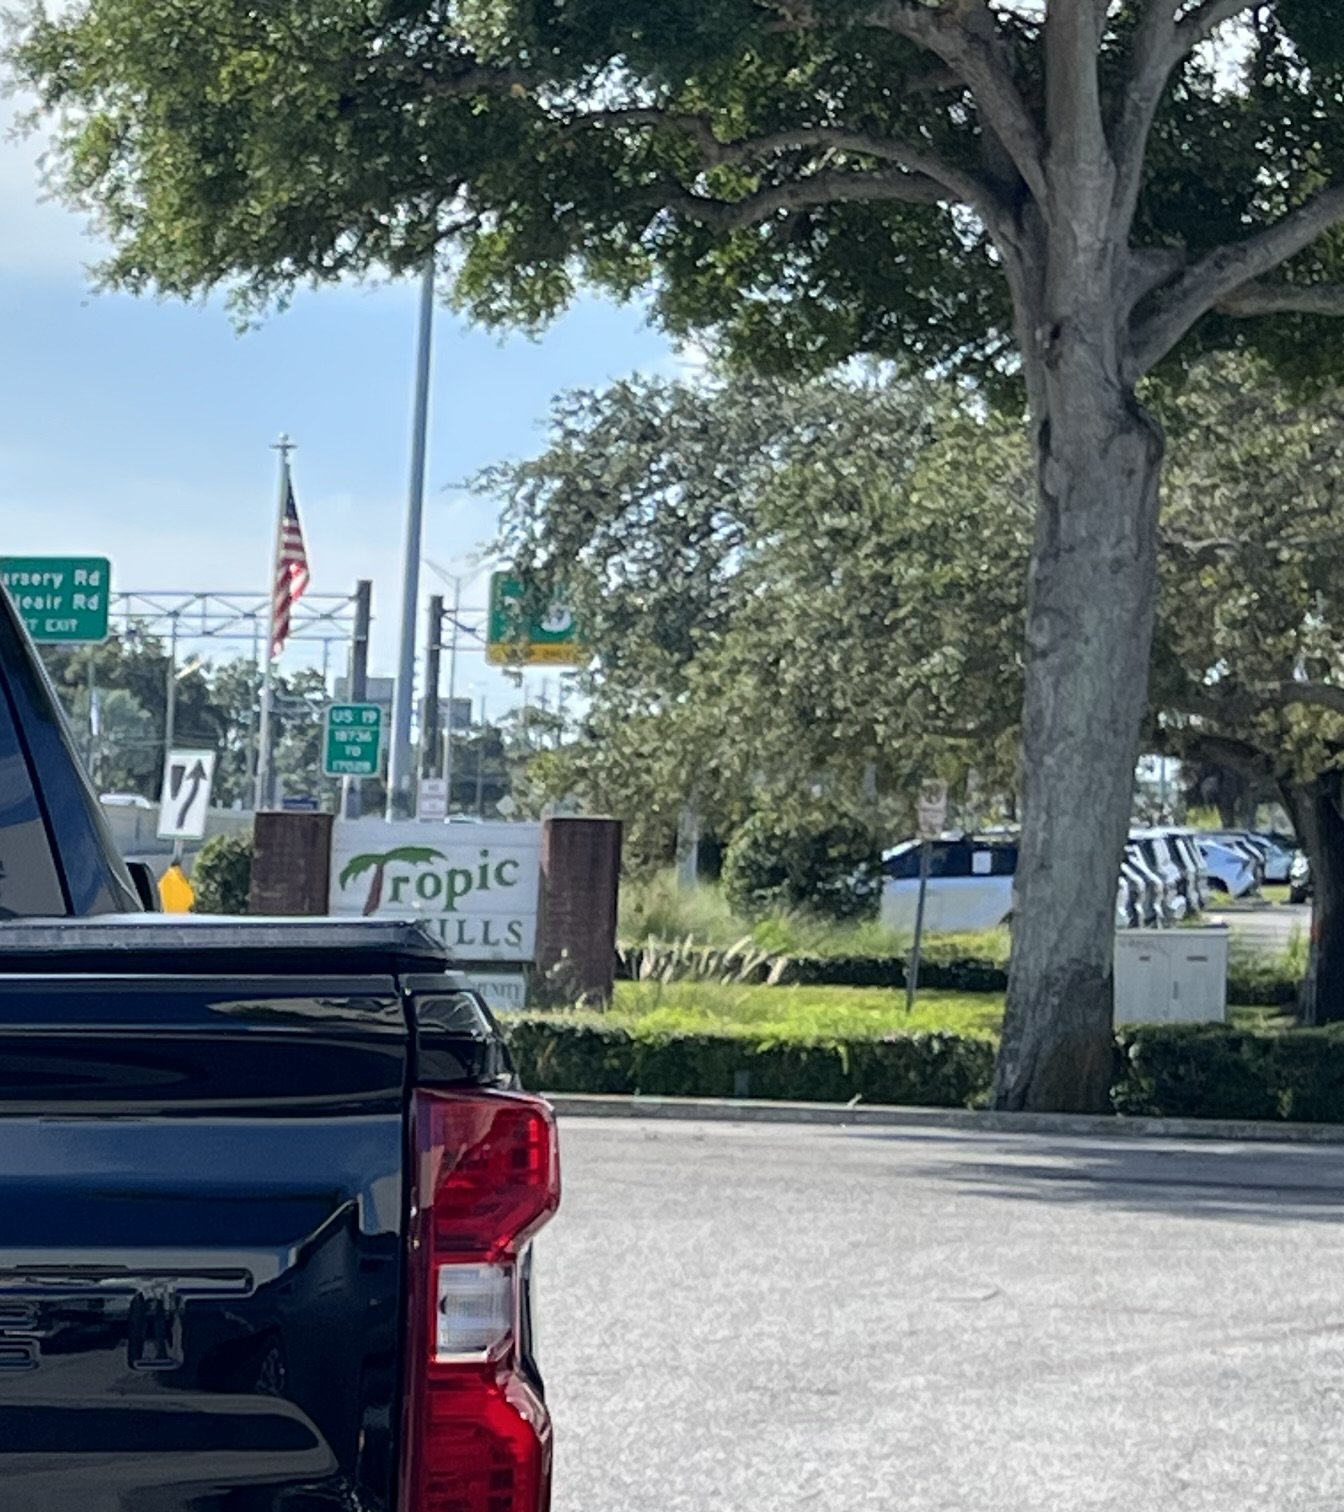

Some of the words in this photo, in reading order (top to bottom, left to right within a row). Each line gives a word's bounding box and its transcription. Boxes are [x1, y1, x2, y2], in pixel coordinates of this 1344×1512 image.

[0, 572, 63, 590] ursery
[74, 569, 100, 586] Rd
[13, 592, 62, 611] leair
[72, 592, 99, 611] Rd
[44, 618, 78, 632] EXIT
[332, 709, 353, 723] US
[344, 745, 362, 757] TO
[339, 846, 520, 916] Tropic
[424, 919, 523, 946] ILLS
